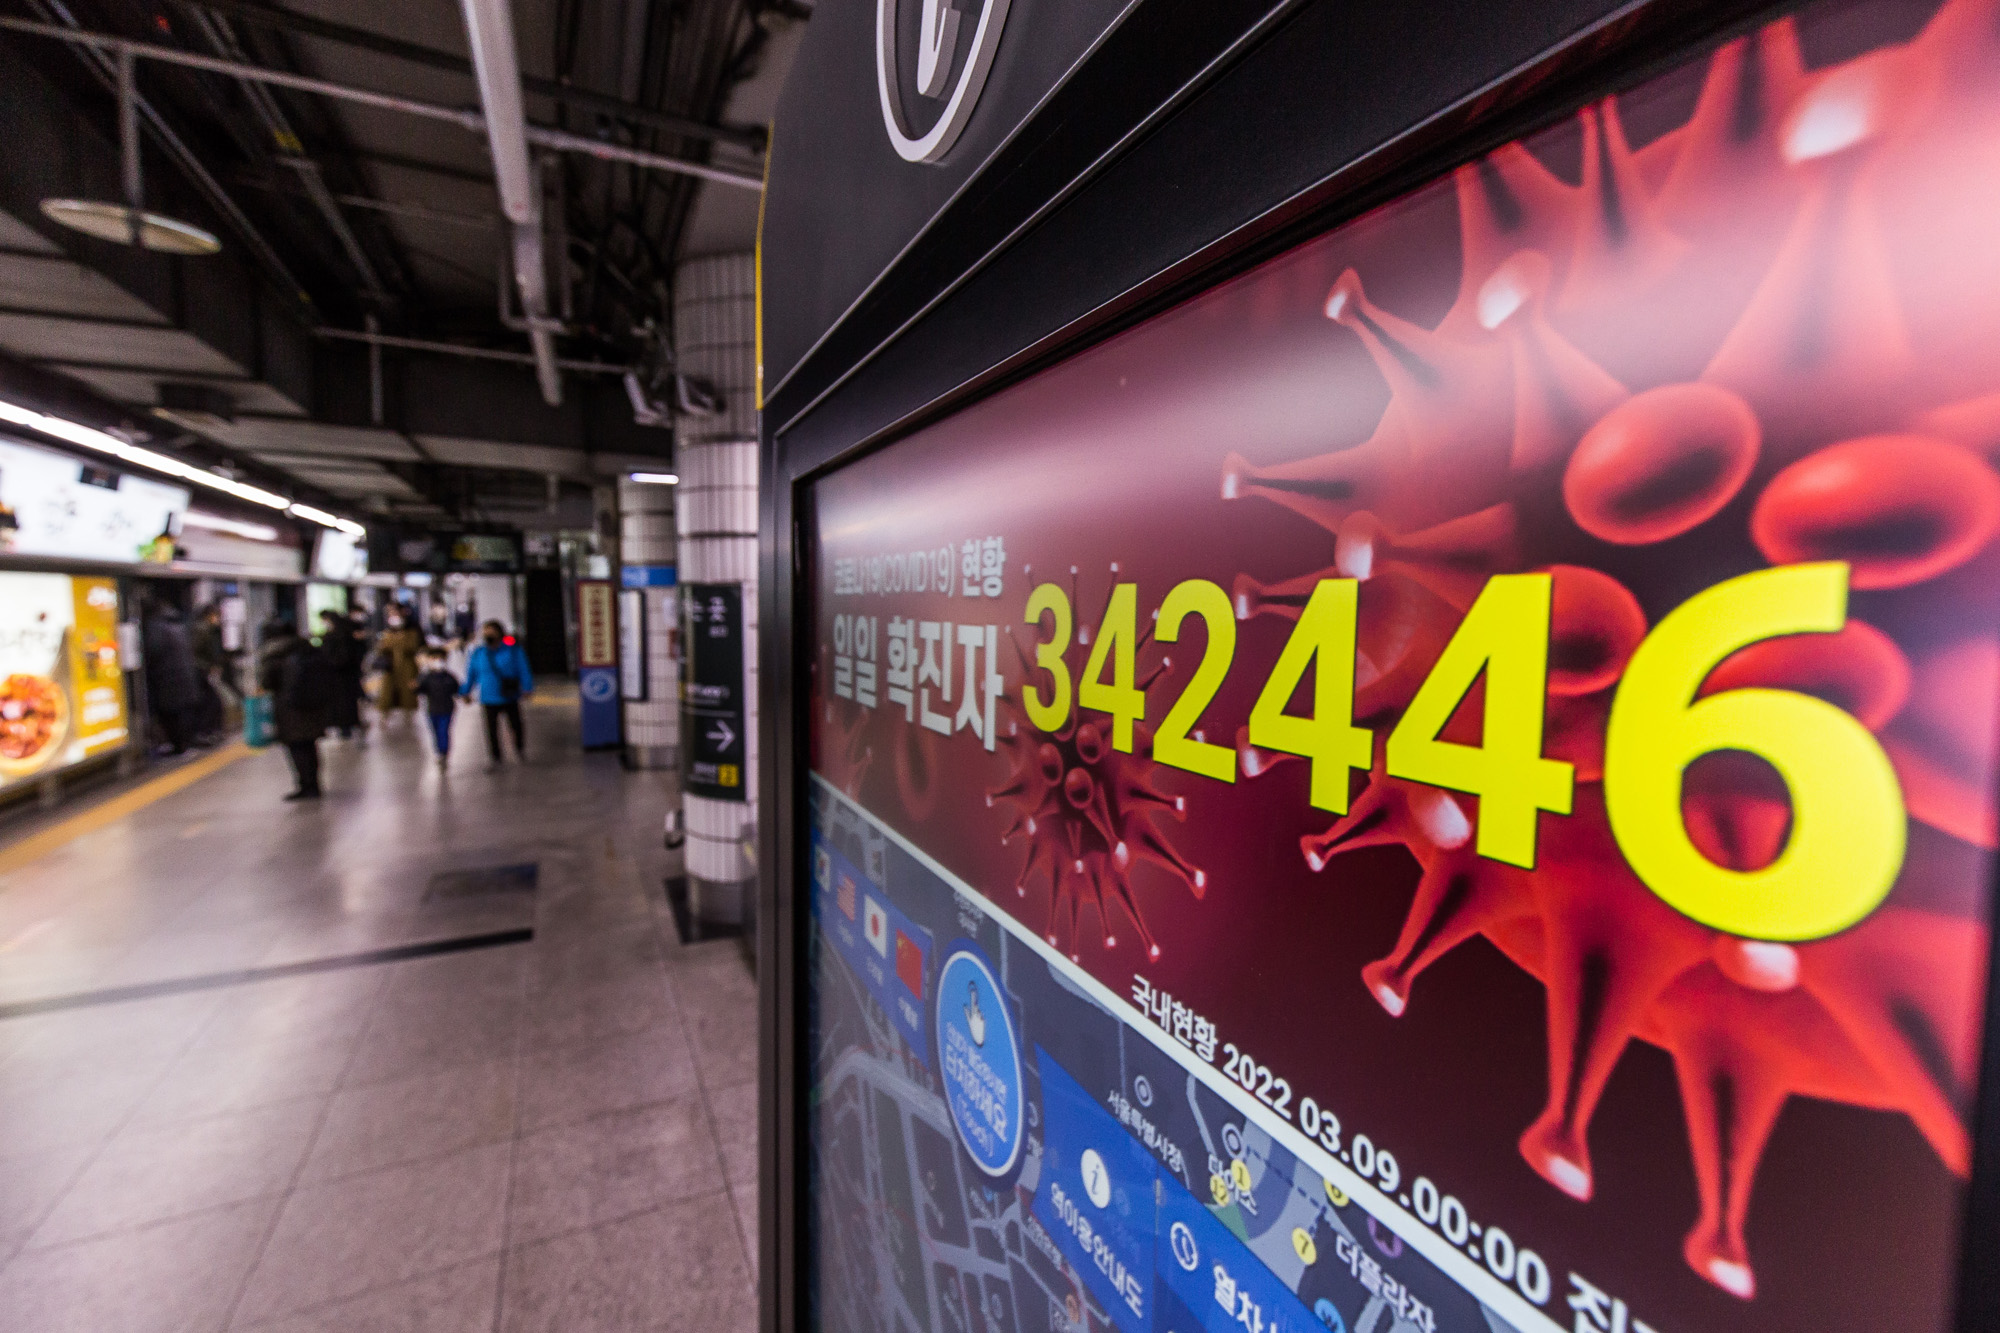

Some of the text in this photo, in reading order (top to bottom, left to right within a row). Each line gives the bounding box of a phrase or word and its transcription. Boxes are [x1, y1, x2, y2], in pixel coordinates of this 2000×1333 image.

[961, 536, 1006, 597] 현황
[833, 560, 1907, 942] 일일 확진자 342446
[1131, 973, 1218, 1063] 국내현황
[1222, 1043, 1292, 1120] 2022
[1299, 1097, 1551, 1304] 03.09.00:00
[1051, 1182, 1143, 1319] 역이용안내도
[1213, 1264, 1279, 1333] 열차
[1335, 1234, 1438, 1333] 더플라자
